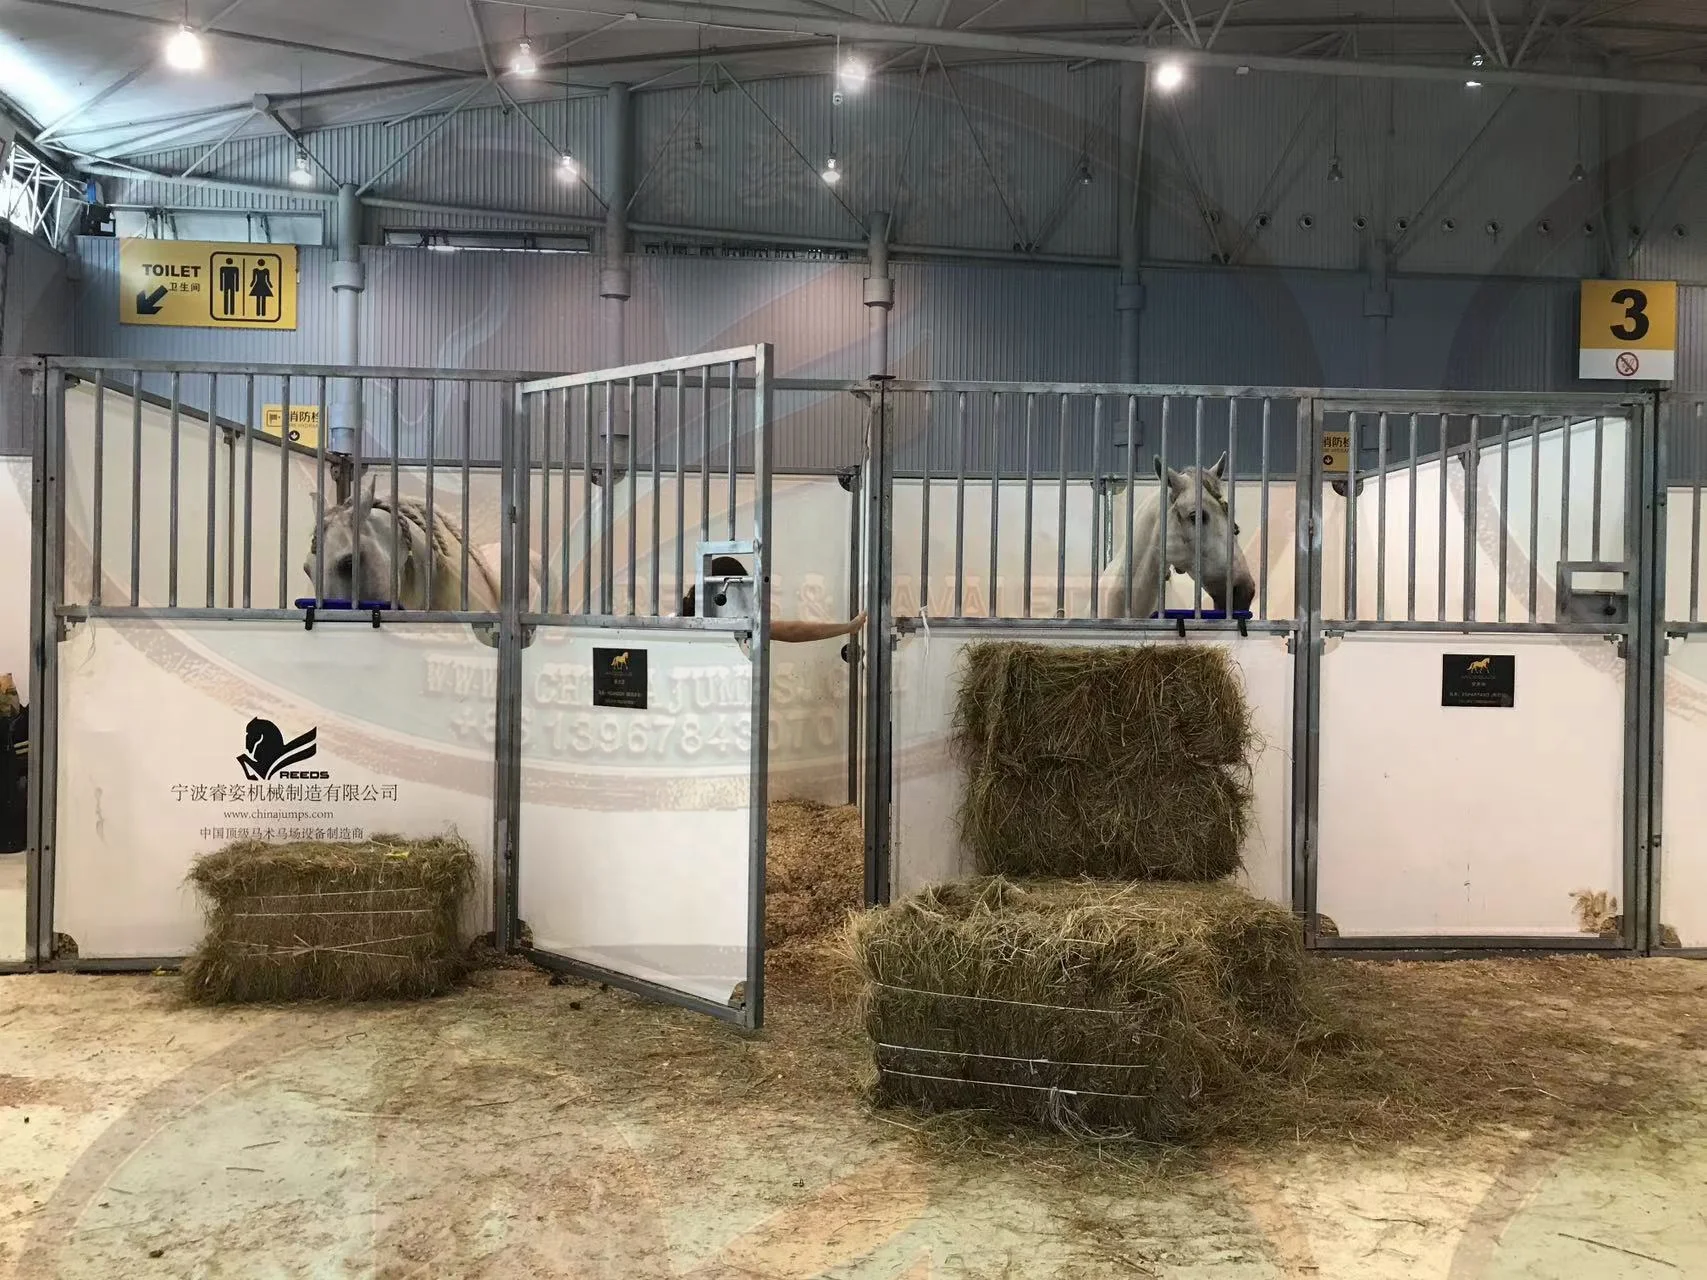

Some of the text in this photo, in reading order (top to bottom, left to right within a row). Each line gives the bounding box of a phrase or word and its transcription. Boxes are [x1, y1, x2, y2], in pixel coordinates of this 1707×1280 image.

[142, 264, 201, 278] TOILET
[169, 281, 201, 292] 卫生间
[1609, 288, 1650, 341] 3
[279, 771, 330, 780] REEDS
[170, 783, 399, 802] 宁波睿姿机械制造有限公司
[223, 808, 334, 821] www.chinajumps.com
[199, 826, 364, 841] 中国顶级马术马场设备制造商
